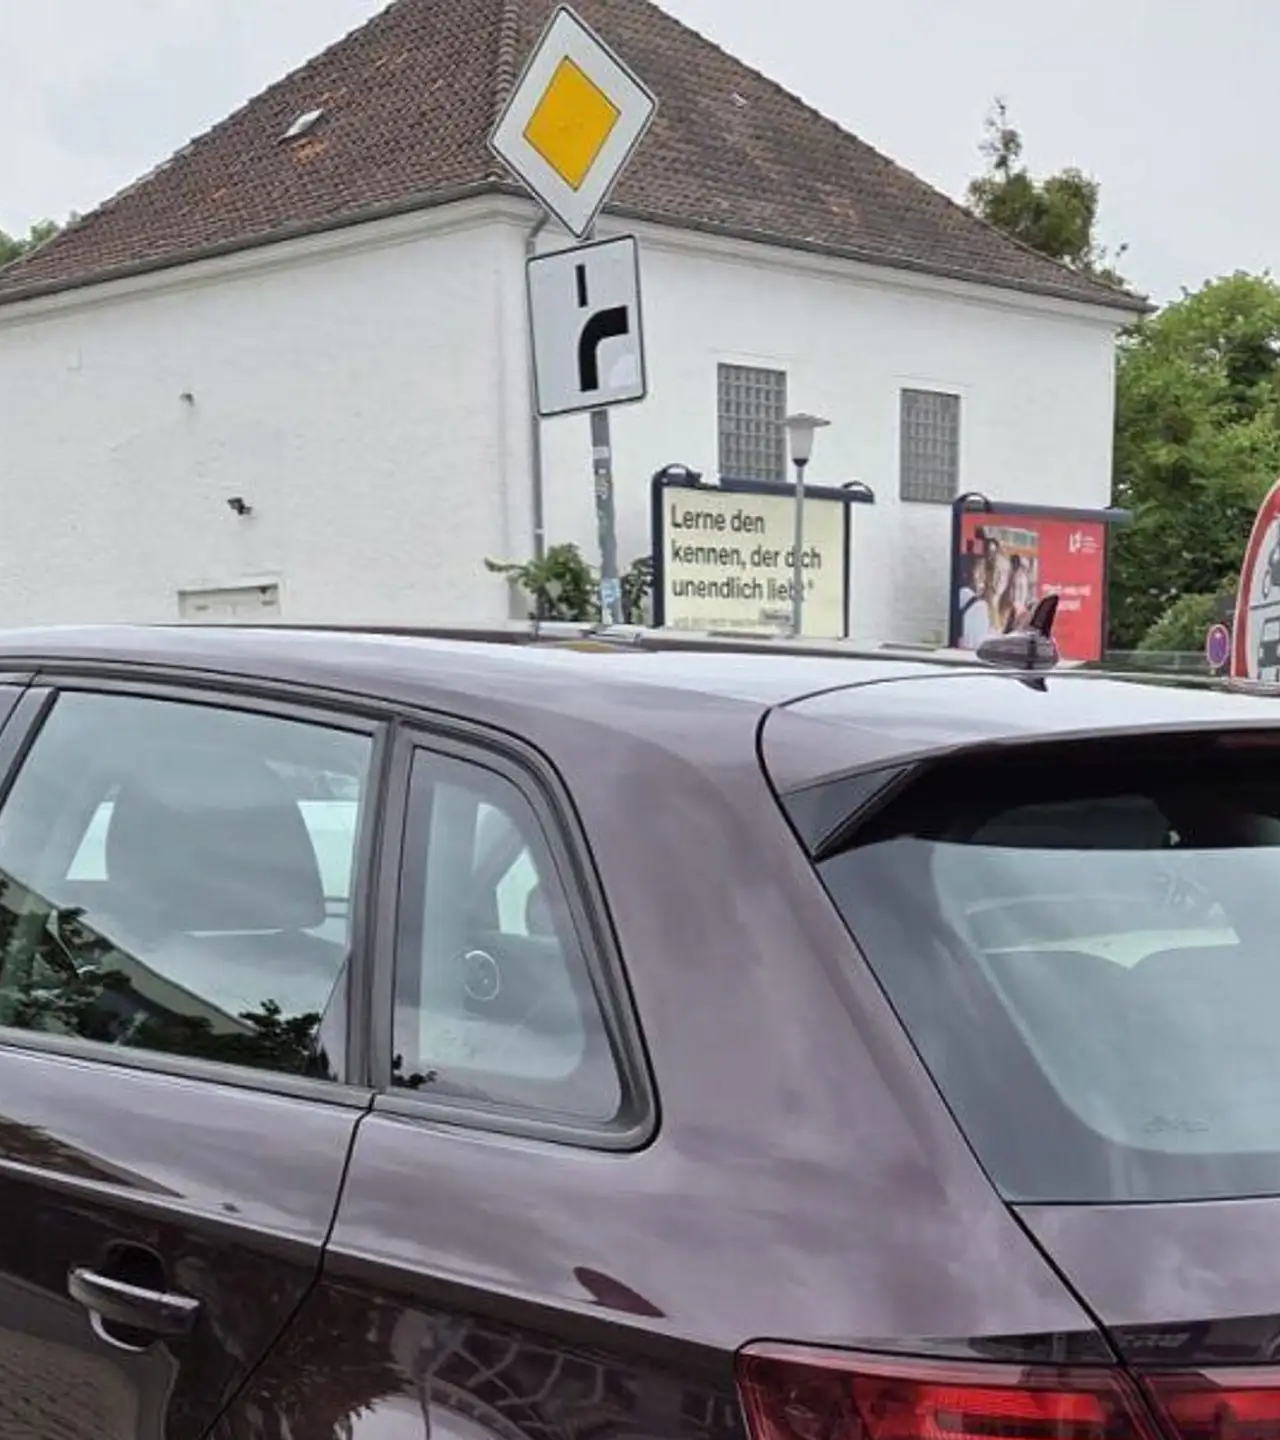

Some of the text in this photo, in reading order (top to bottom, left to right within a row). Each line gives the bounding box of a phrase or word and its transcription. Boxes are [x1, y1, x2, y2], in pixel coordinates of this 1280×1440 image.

[671, 504, 765, 533] Lerne den
[671, 539, 822, 570] kennen, der dch
[672, 577, 763, 600] unendlich
